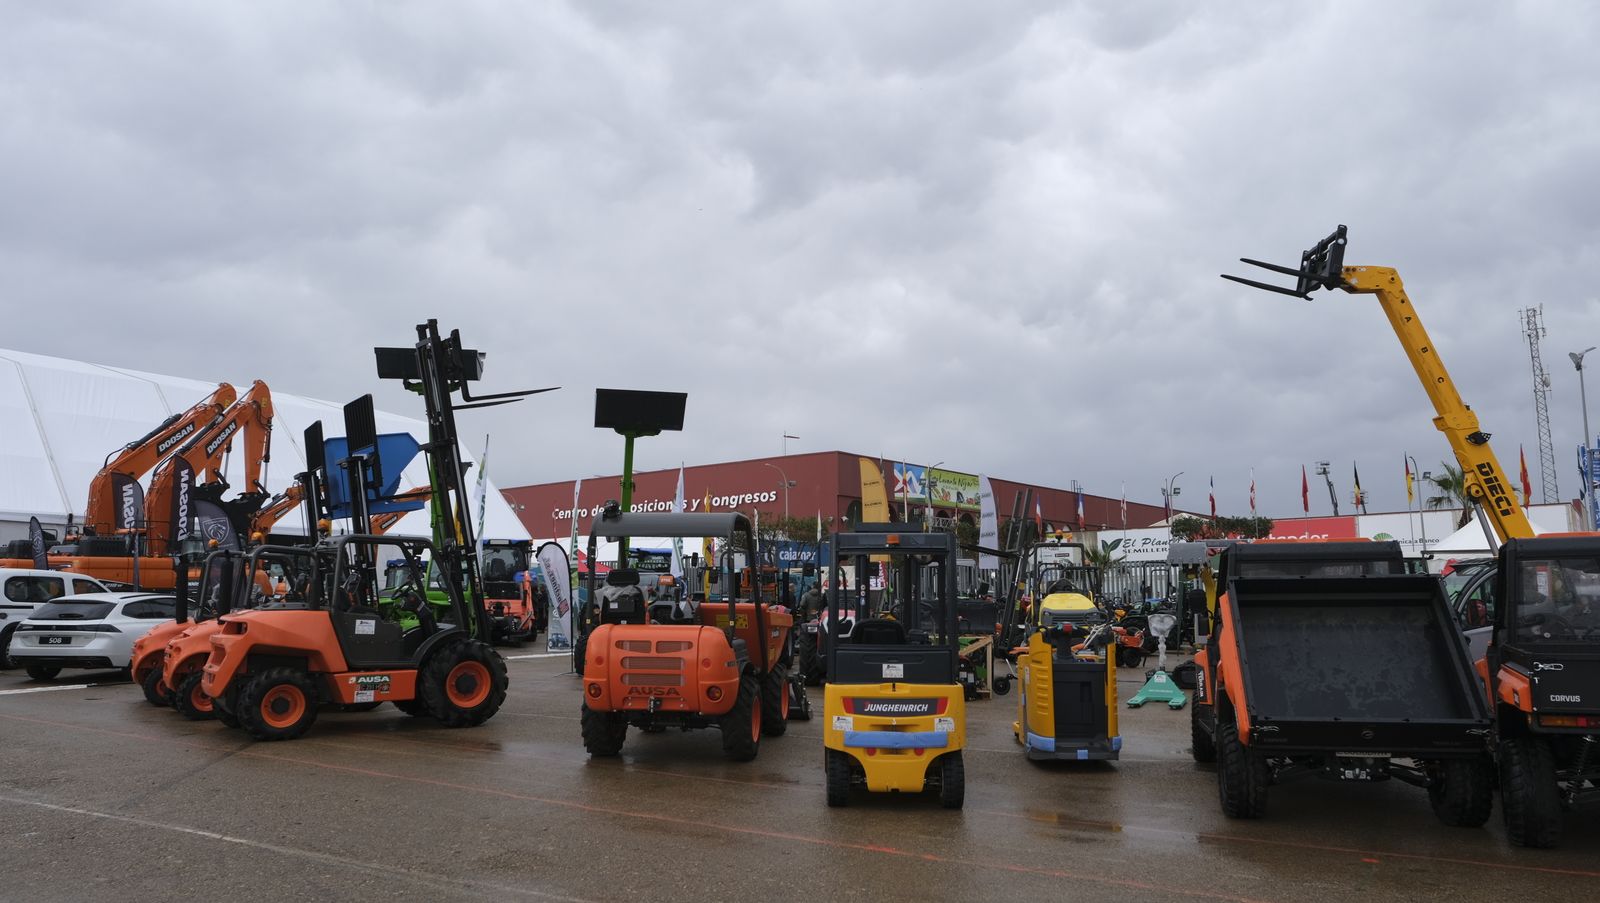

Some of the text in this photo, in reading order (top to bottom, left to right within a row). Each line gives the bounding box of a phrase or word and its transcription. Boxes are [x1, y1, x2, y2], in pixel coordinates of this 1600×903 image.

[1420, 346, 1429, 354] B
[1436, 376, 1445, 384] C
[158, 423, 195, 452] DOOSAN
[206, 421, 237, 454] DOOSAN
[690, 498, 701, 511] y
[1122, 537, 1172, 548] El Plant
[357, 675, 390, 683] AUSA
[627, 686, 681, 696] AUSA
[1549, 694, 1581, 703] CORVUS
[863, 703, 929, 712] JUNGHEINRICH
